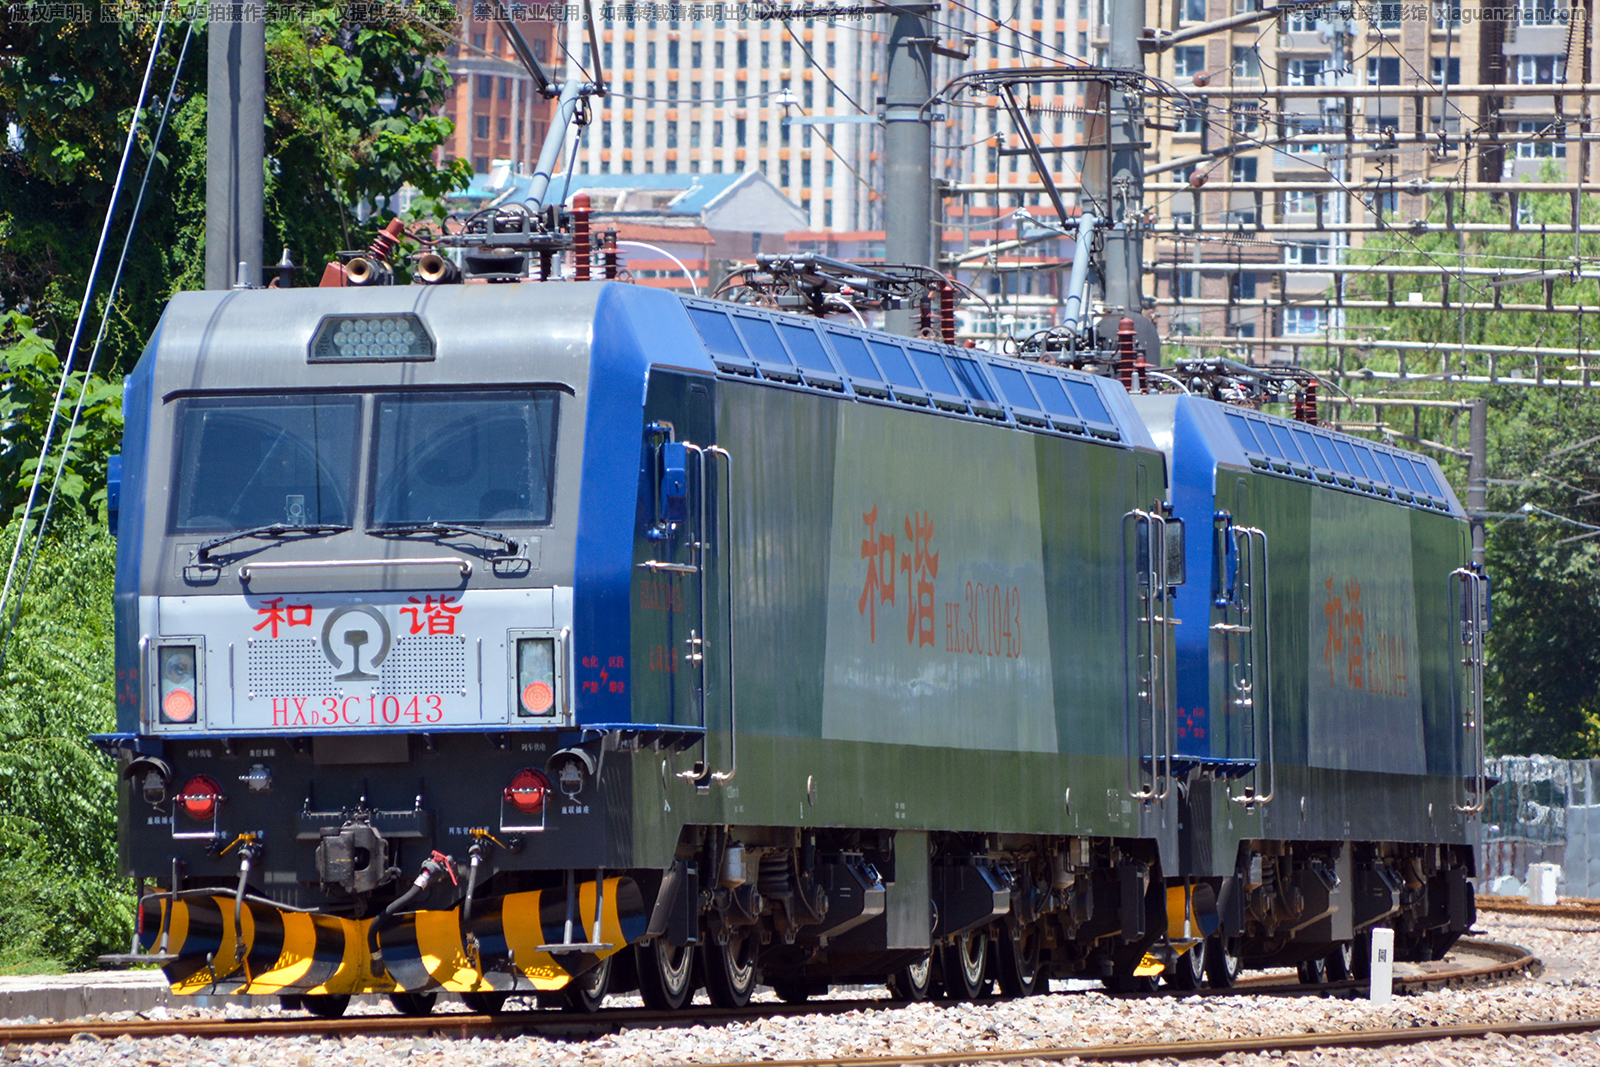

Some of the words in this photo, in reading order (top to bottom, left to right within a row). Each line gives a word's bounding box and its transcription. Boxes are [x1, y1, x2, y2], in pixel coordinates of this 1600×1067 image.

[252, 596, 313, 638] 和
[399, 593, 463, 636] 谐
[858, 503, 939, 649] 和谐
[1324, 571, 1363, 690] 和谐
[271, 695, 443, 726] HXD3C1043
